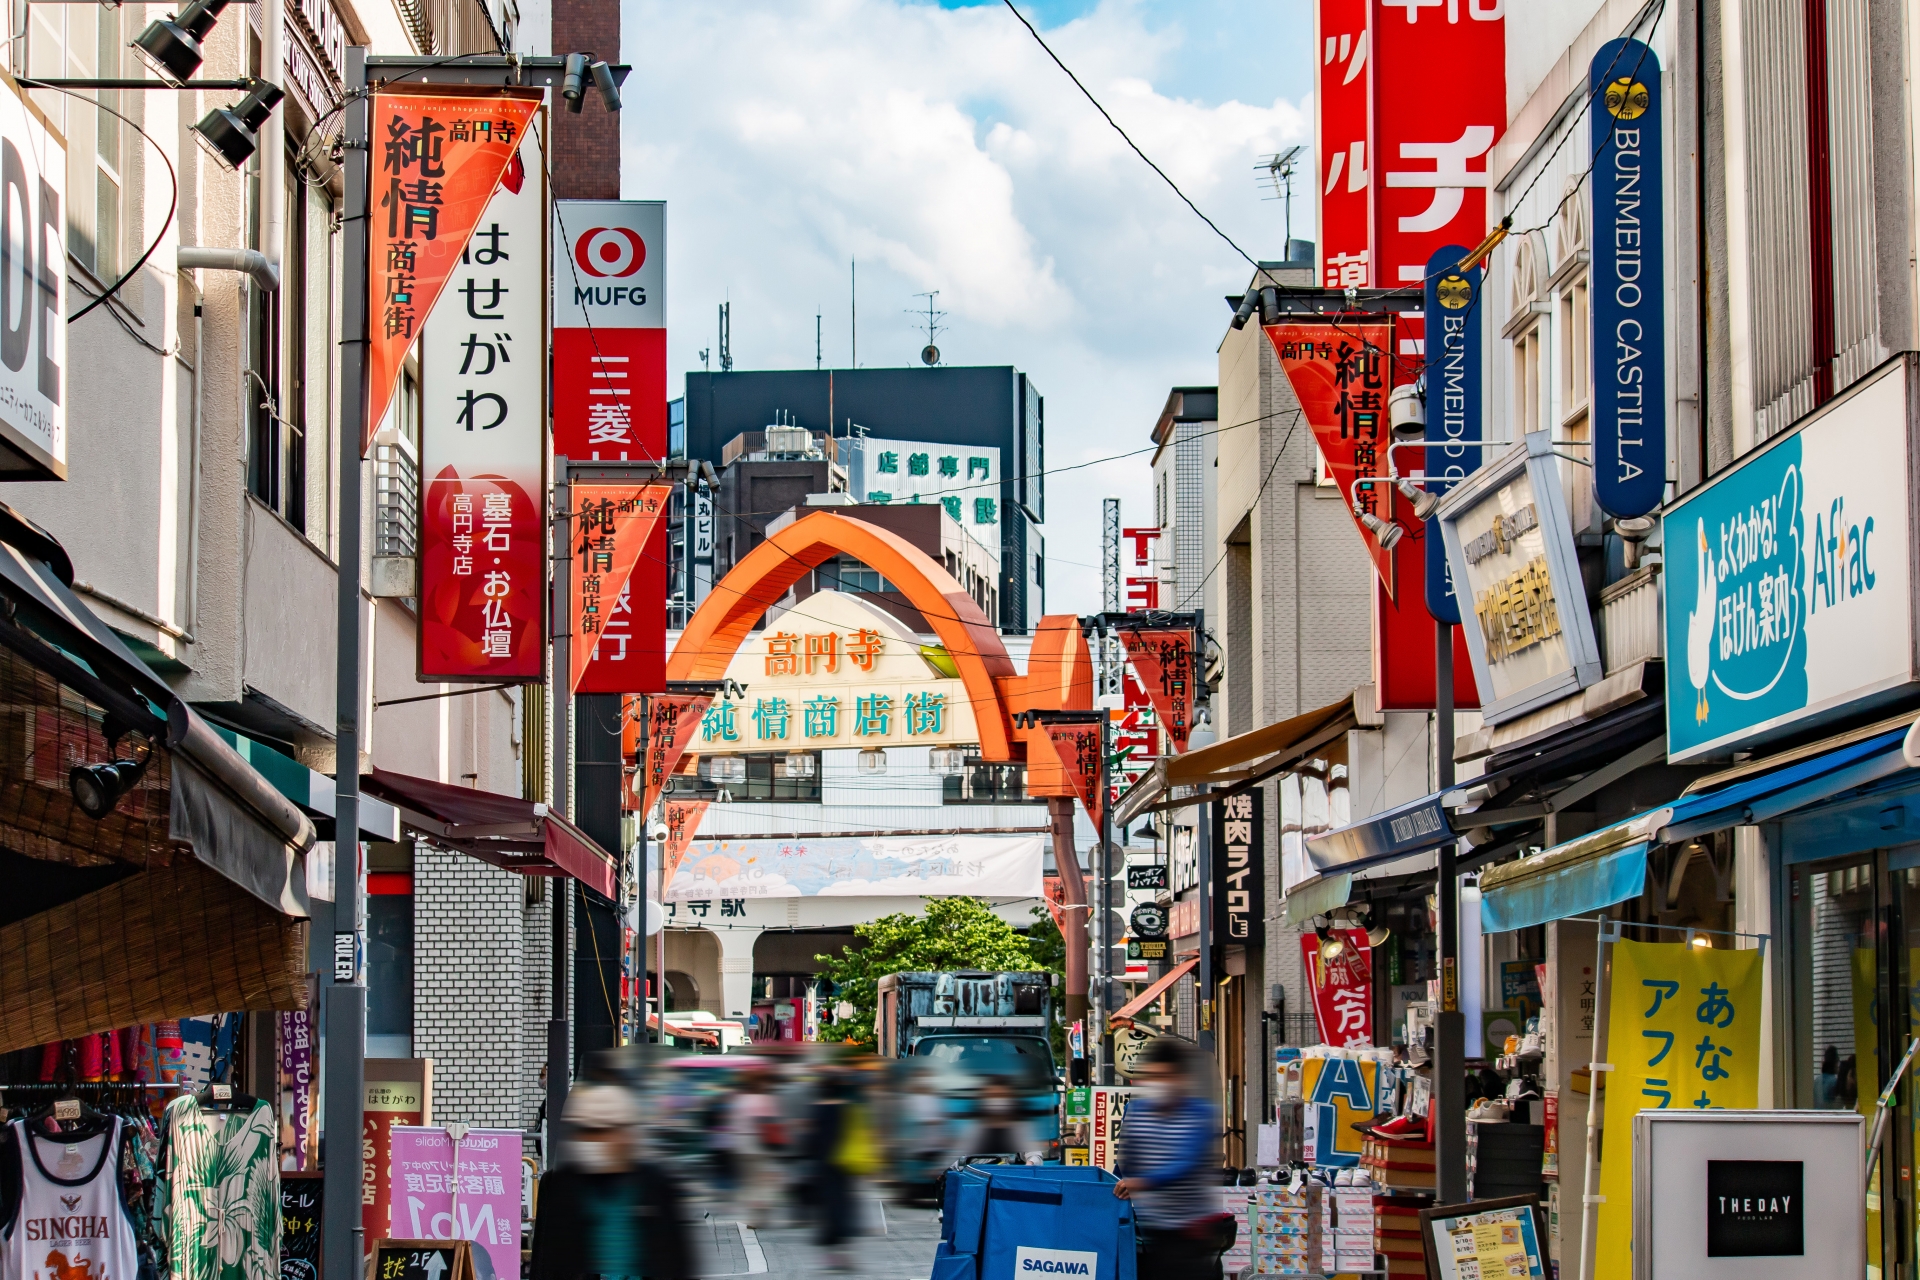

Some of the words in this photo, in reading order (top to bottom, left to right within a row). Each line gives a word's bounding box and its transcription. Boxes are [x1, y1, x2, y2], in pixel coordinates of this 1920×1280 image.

[388, 103, 418, 111] Koenji
[452, 106, 494, 114] Shopping
[448, 118, 517, 145] 高円寺
[381, 113, 446, 340] 純情商店街
[1615, 127, 1644, 308] BUNMEIDO
[573, 286, 647, 306] MUFG
[456, 223, 512, 432] はせがわ
[1280, 341, 1334, 361] 高円寺
[1443, 315, 1465, 458] BUNMEIDO
[1616, 318, 1645, 484] CASTILLA
[878, 450, 991, 481] 店舗専門
[452, 493, 473, 576] 高円寺店
[617, 498, 659, 513] 高円寺
[578, 497, 616, 635] 純情商店街
[1717, 494, 1778, 582] よくわかる!
[1810, 496, 1876, 616] Aflac
[482, 493, 512, 658] 墓石・お仏壇
[1719, 564, 1790, 661] ほけん案内
[763, 628, 884, 678] 高円寺
[701, 690, 946, 744] 純情商店街
[1159, 639, 1189, 743] 純情商店街
[651, 702, 678, 787] 純情商店街
[1075, 730, 1098, 811] 純情商店街
[668, 806, 685, 869] 純情商店街
[1222, 793, 1252, 913] 焼肉ライク
[1401, 991, 1425, 1001] NOV
[1580, 980, 1596, 1031] 文明堂
[368, 1095, 416, 1105] はせがわ
[26, 1215, 110, 1241] SINGHA
[1719, 1196, 1752, 1215] THE
[1758, 1195, 1791, 1214] DAY
[50, 1239, 73, 1248] LAGER
[410, 1252, 431, 1267] 2F
[1022, 1258, 1090, 1276] SAGAWA
